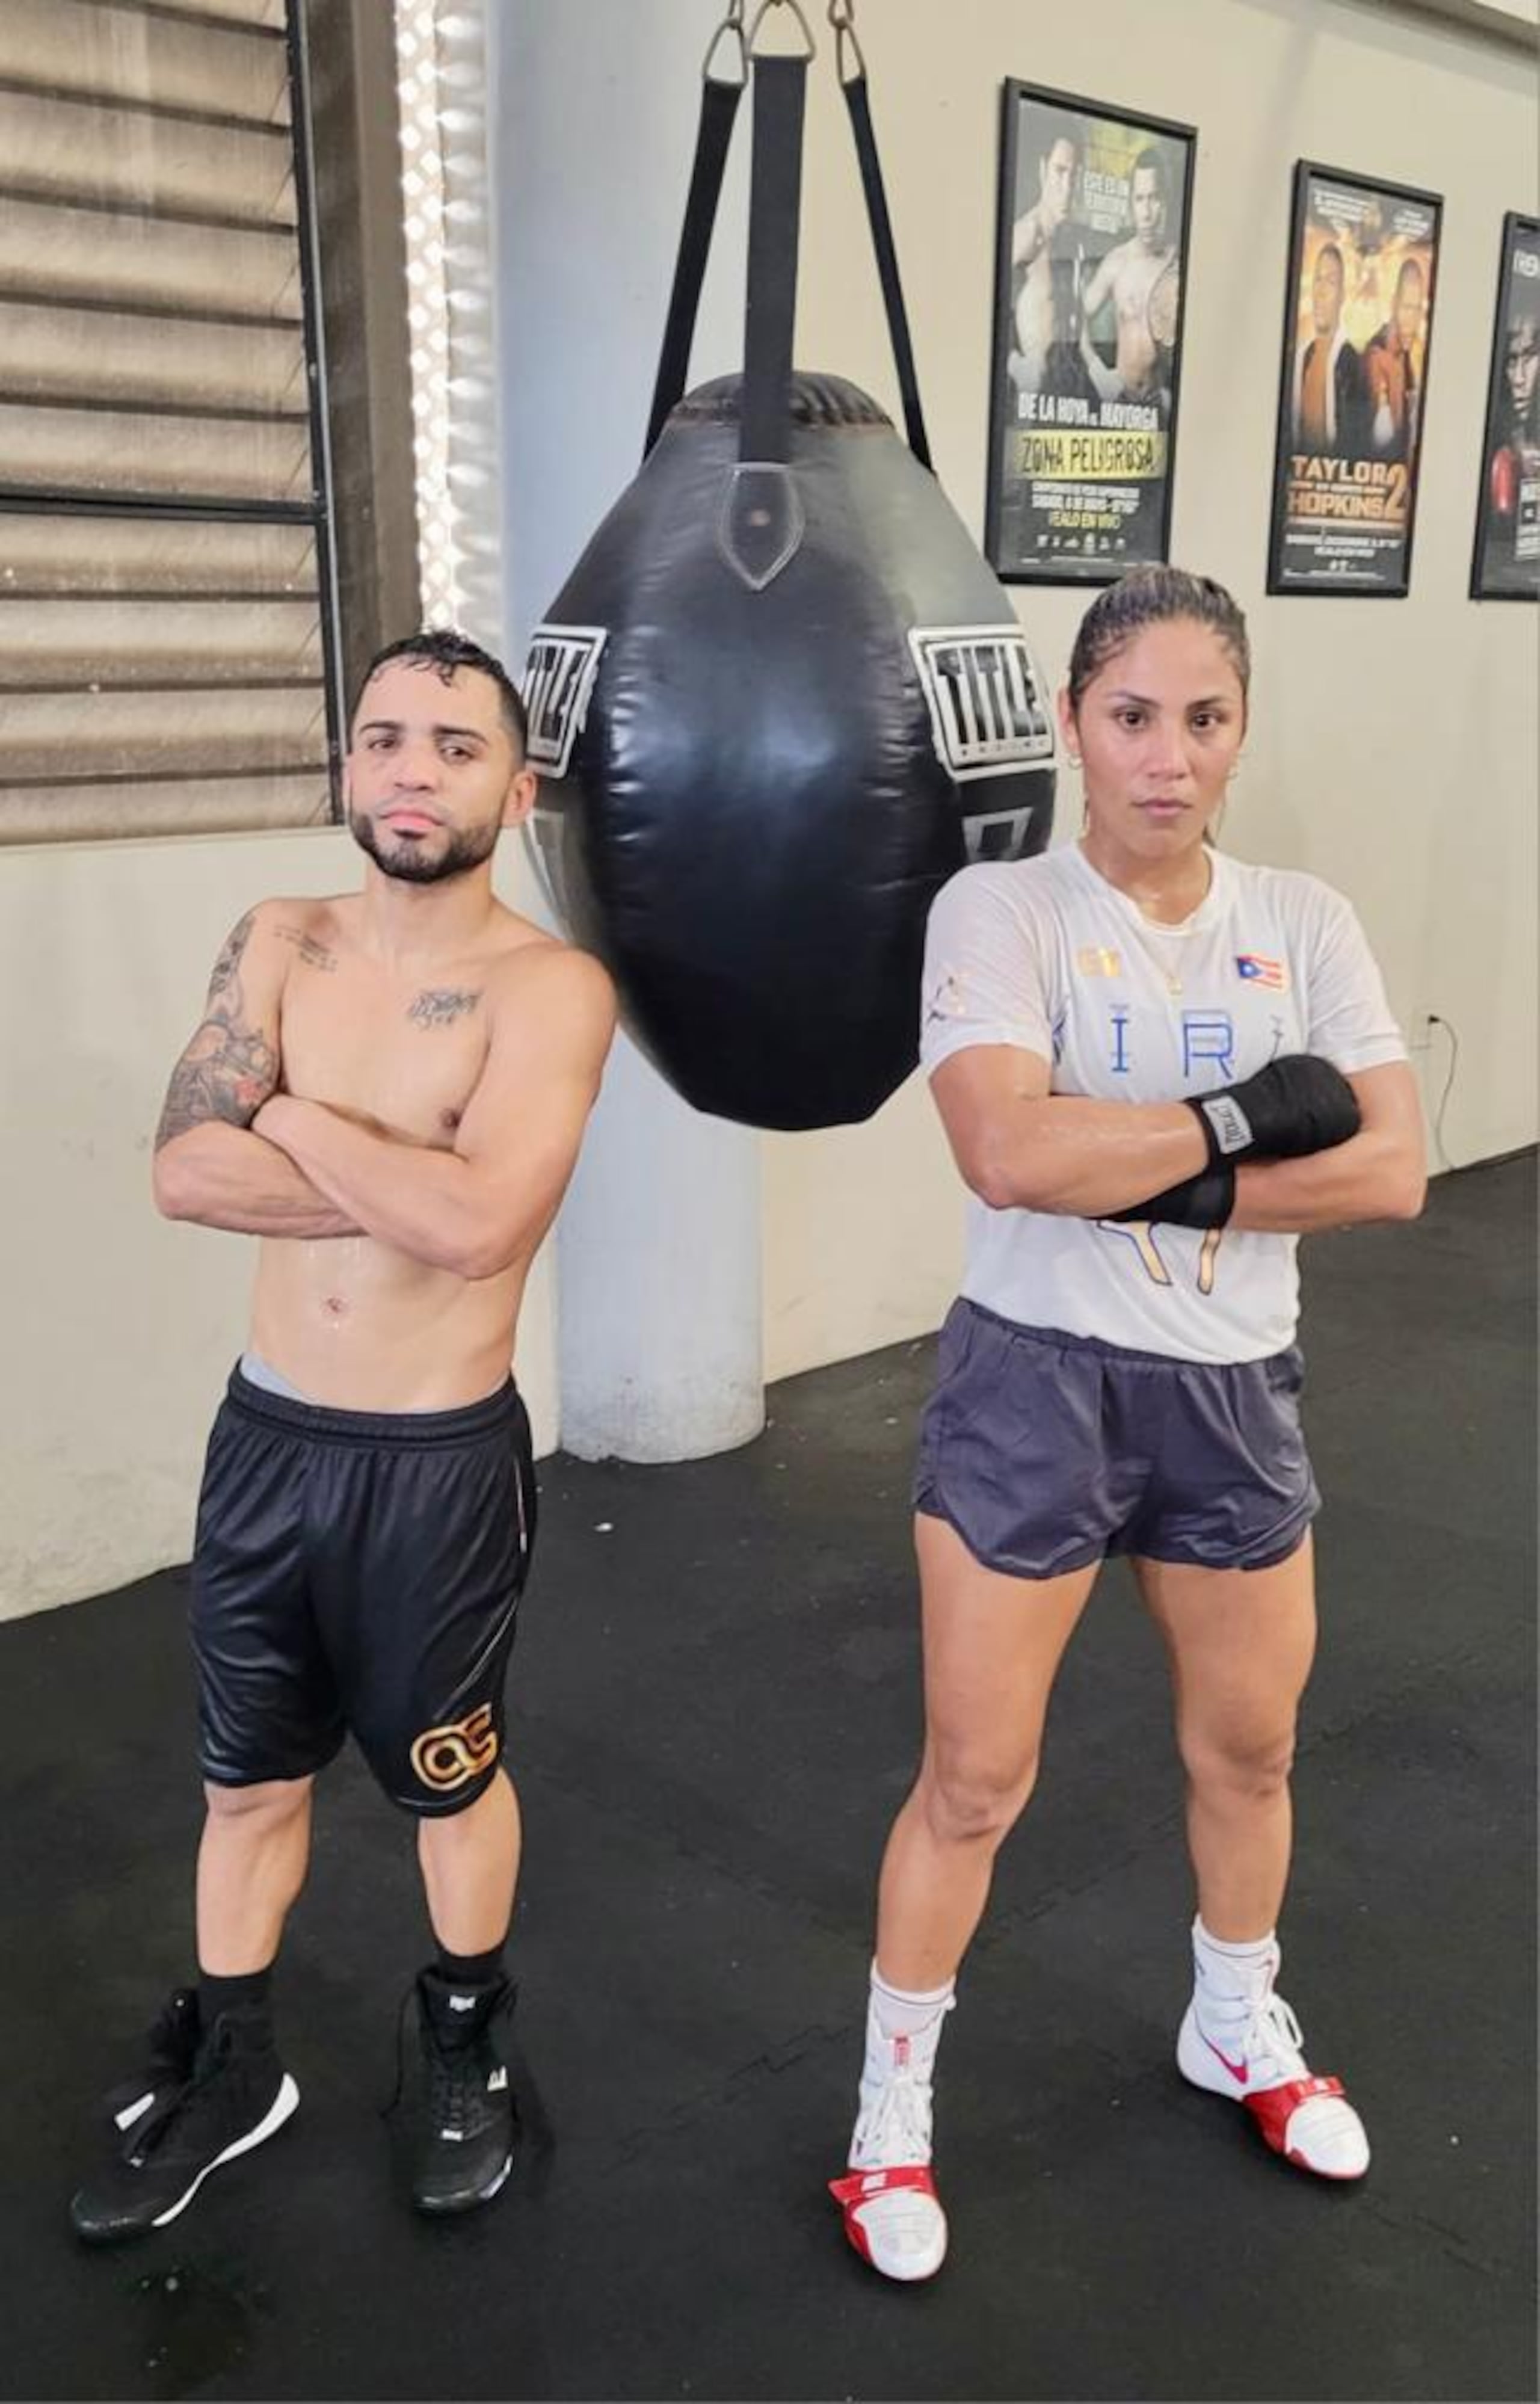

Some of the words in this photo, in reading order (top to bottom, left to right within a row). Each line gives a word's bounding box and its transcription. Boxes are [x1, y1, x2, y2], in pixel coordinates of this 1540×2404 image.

[1018, 392, 1038, 419] DE
[1039, 394, 1055, 421] LA
[1022, 437, 1063, 473] ZONA
[1070, 437, 1154, 473] PELIGROSA
[1291, 455, 1387, 484] TAYLOR
[1287, 491, 1384, 519] HOPKINS
[1384, 463, 1408, 521] 2
[935, 645, 1048, 745] TITLE
